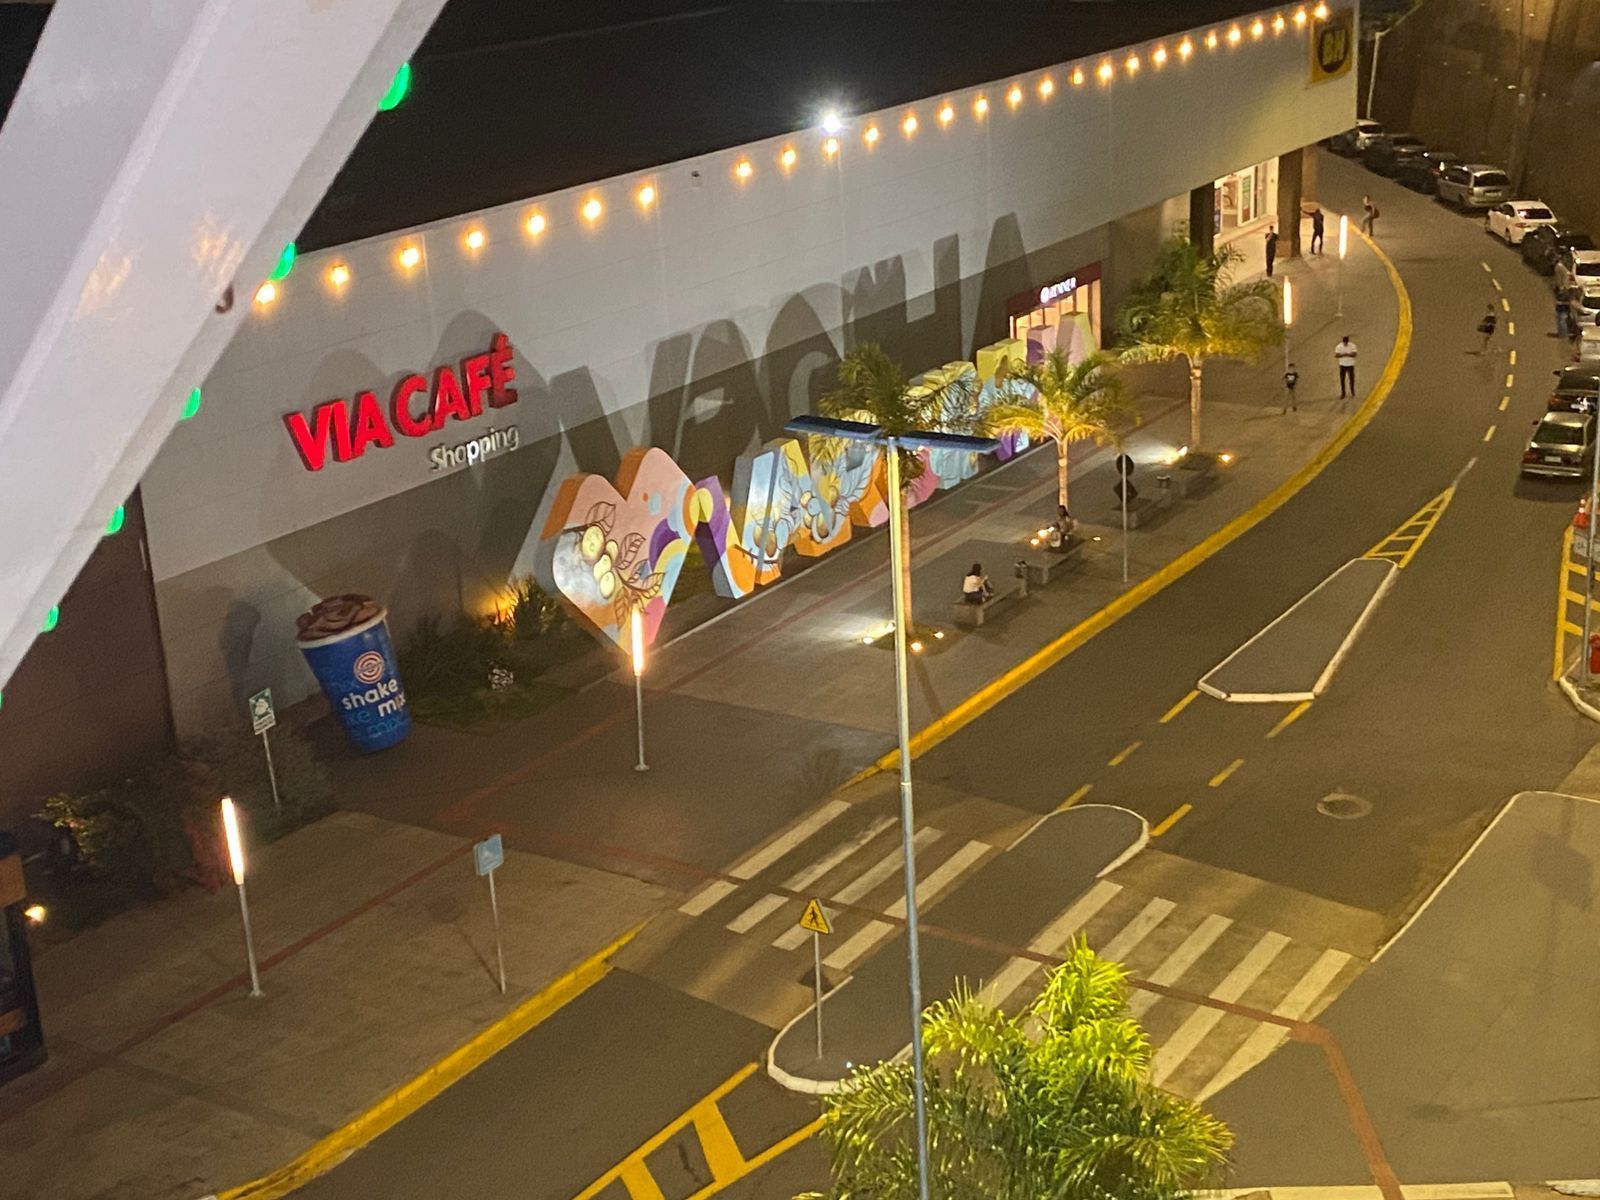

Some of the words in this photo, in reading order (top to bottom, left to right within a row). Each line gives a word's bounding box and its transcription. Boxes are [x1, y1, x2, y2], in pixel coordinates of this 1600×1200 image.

[282, 391, 395, 472] VIA
[390, 331, 518, 438] CAFÉ
[430, 424, 520, 472] Shopping
[341, 678, 399, 711] shake
[377, 690, 407, 718] mix
